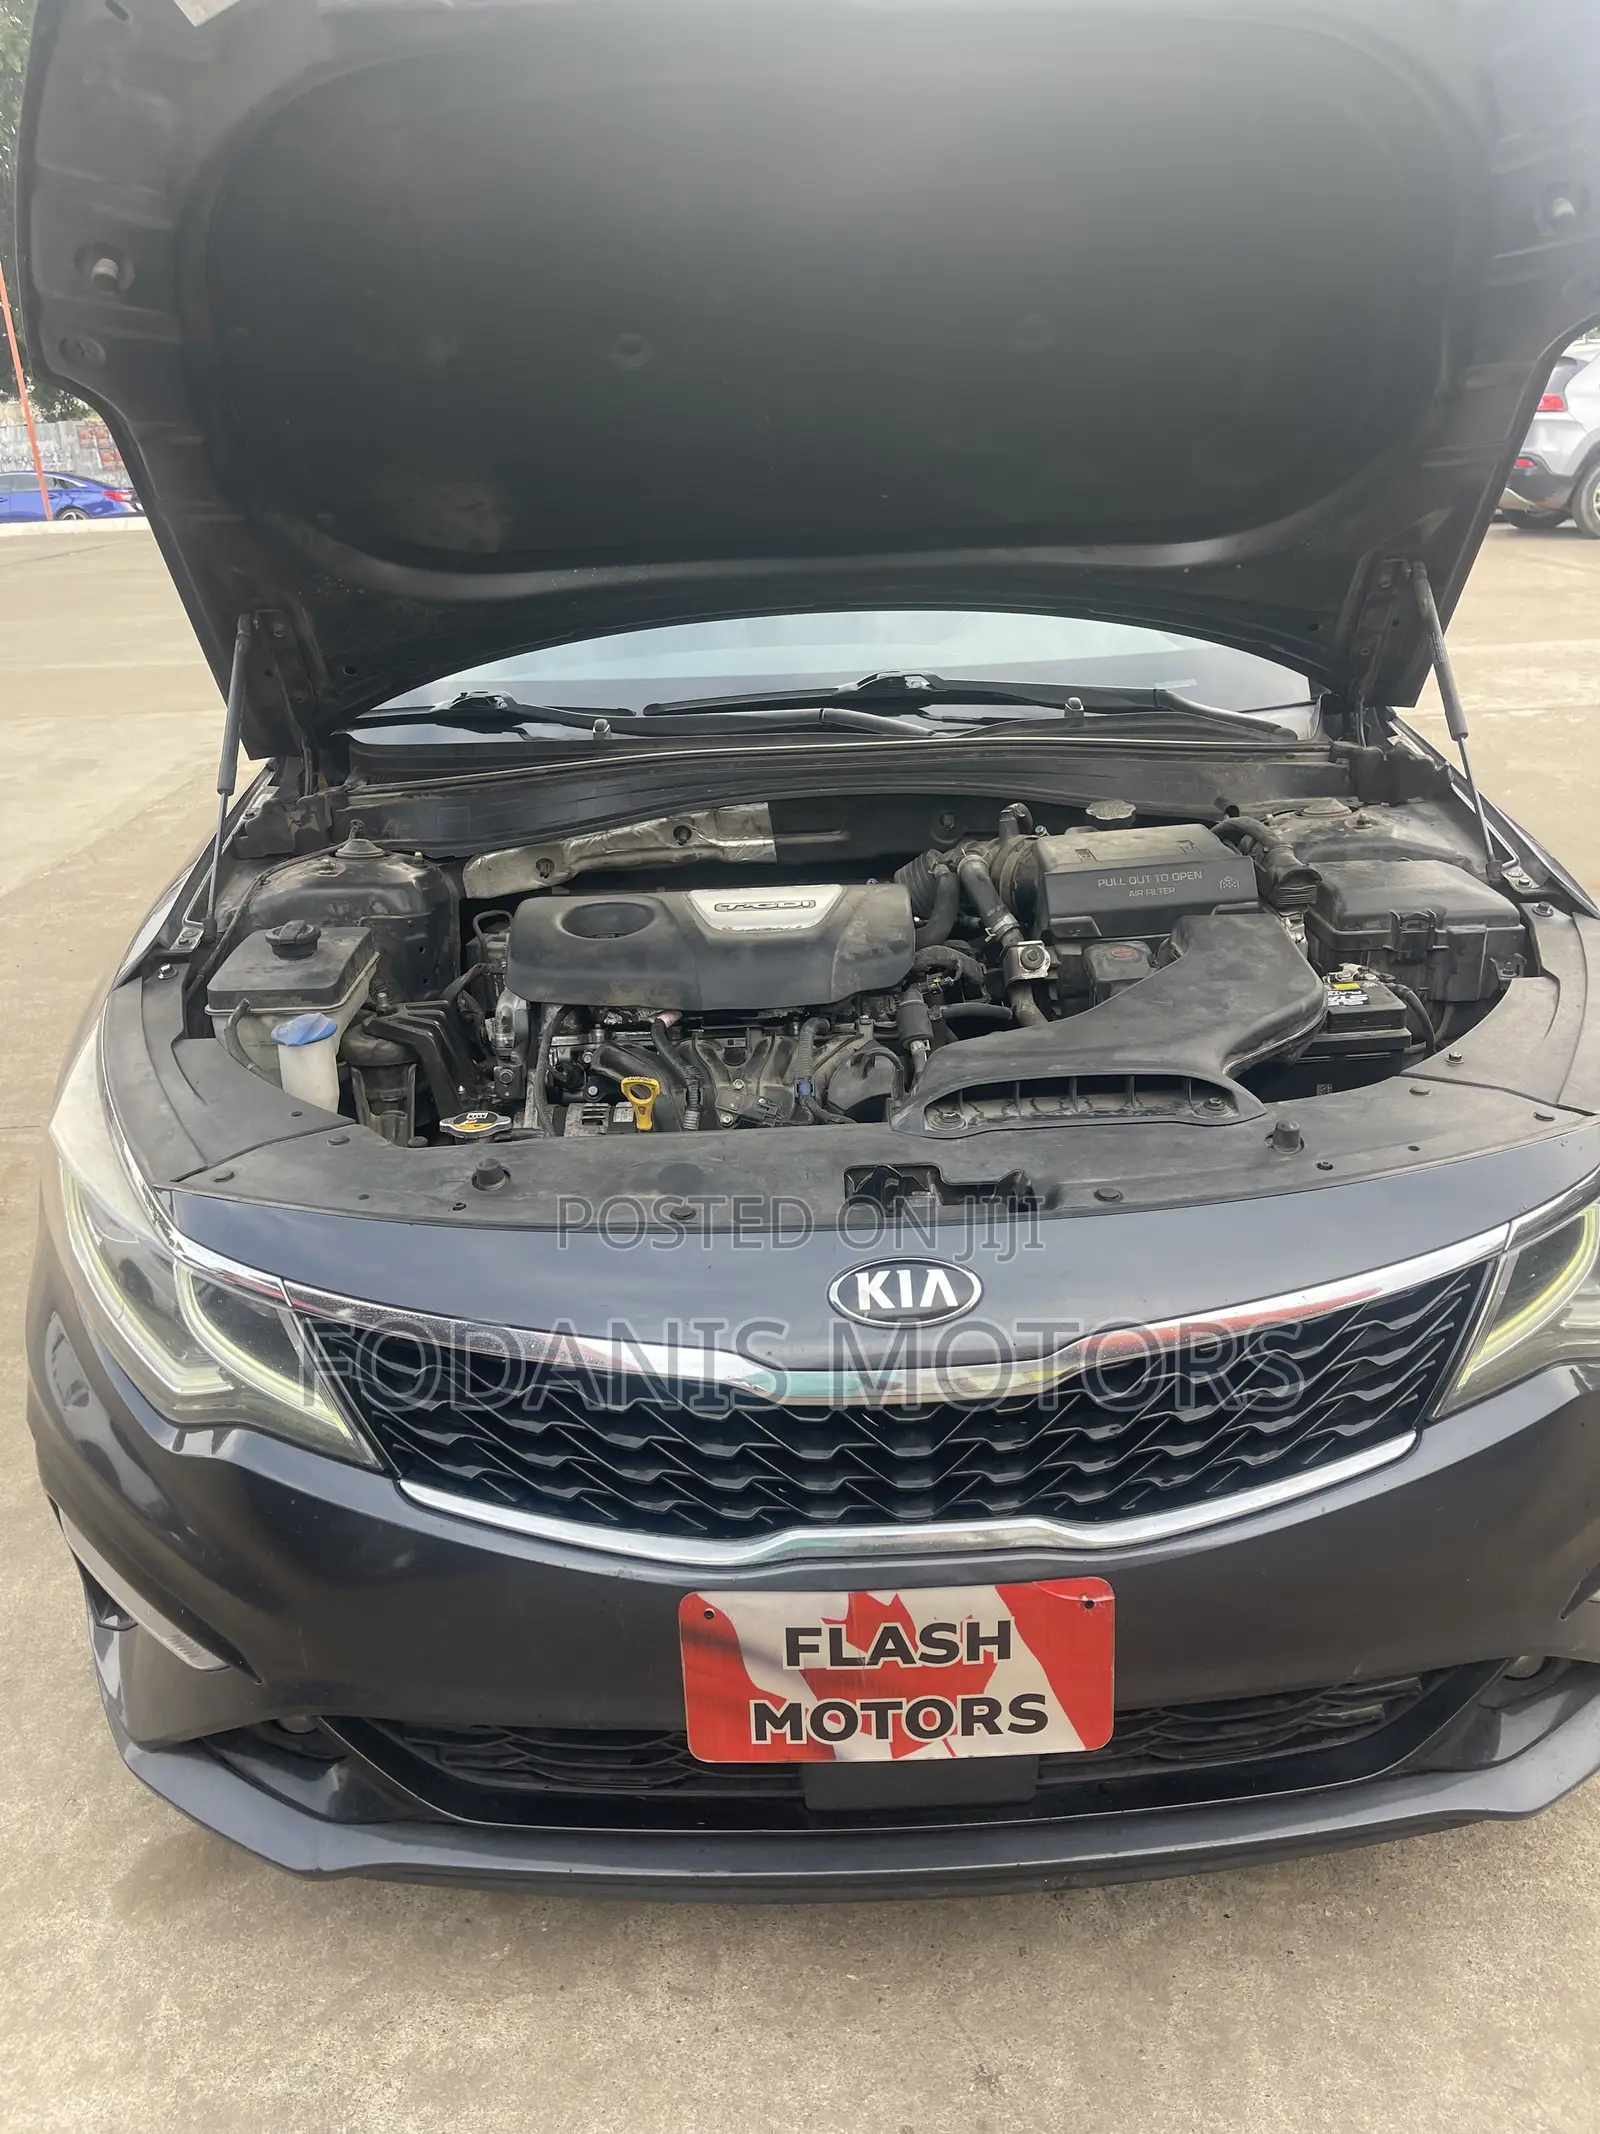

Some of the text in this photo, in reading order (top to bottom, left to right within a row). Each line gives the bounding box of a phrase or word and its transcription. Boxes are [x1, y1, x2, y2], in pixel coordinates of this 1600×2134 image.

[1098, 870, 1202, 888] PULL OUT TO OPEN
[1128, 887, 1176, 898] AIR FILTER
[855, 1269, 960, 1310] KIA
[784, 1618, 1012, 1670] FLASH
[751, 1692, 1050, 1744] MOTORS
